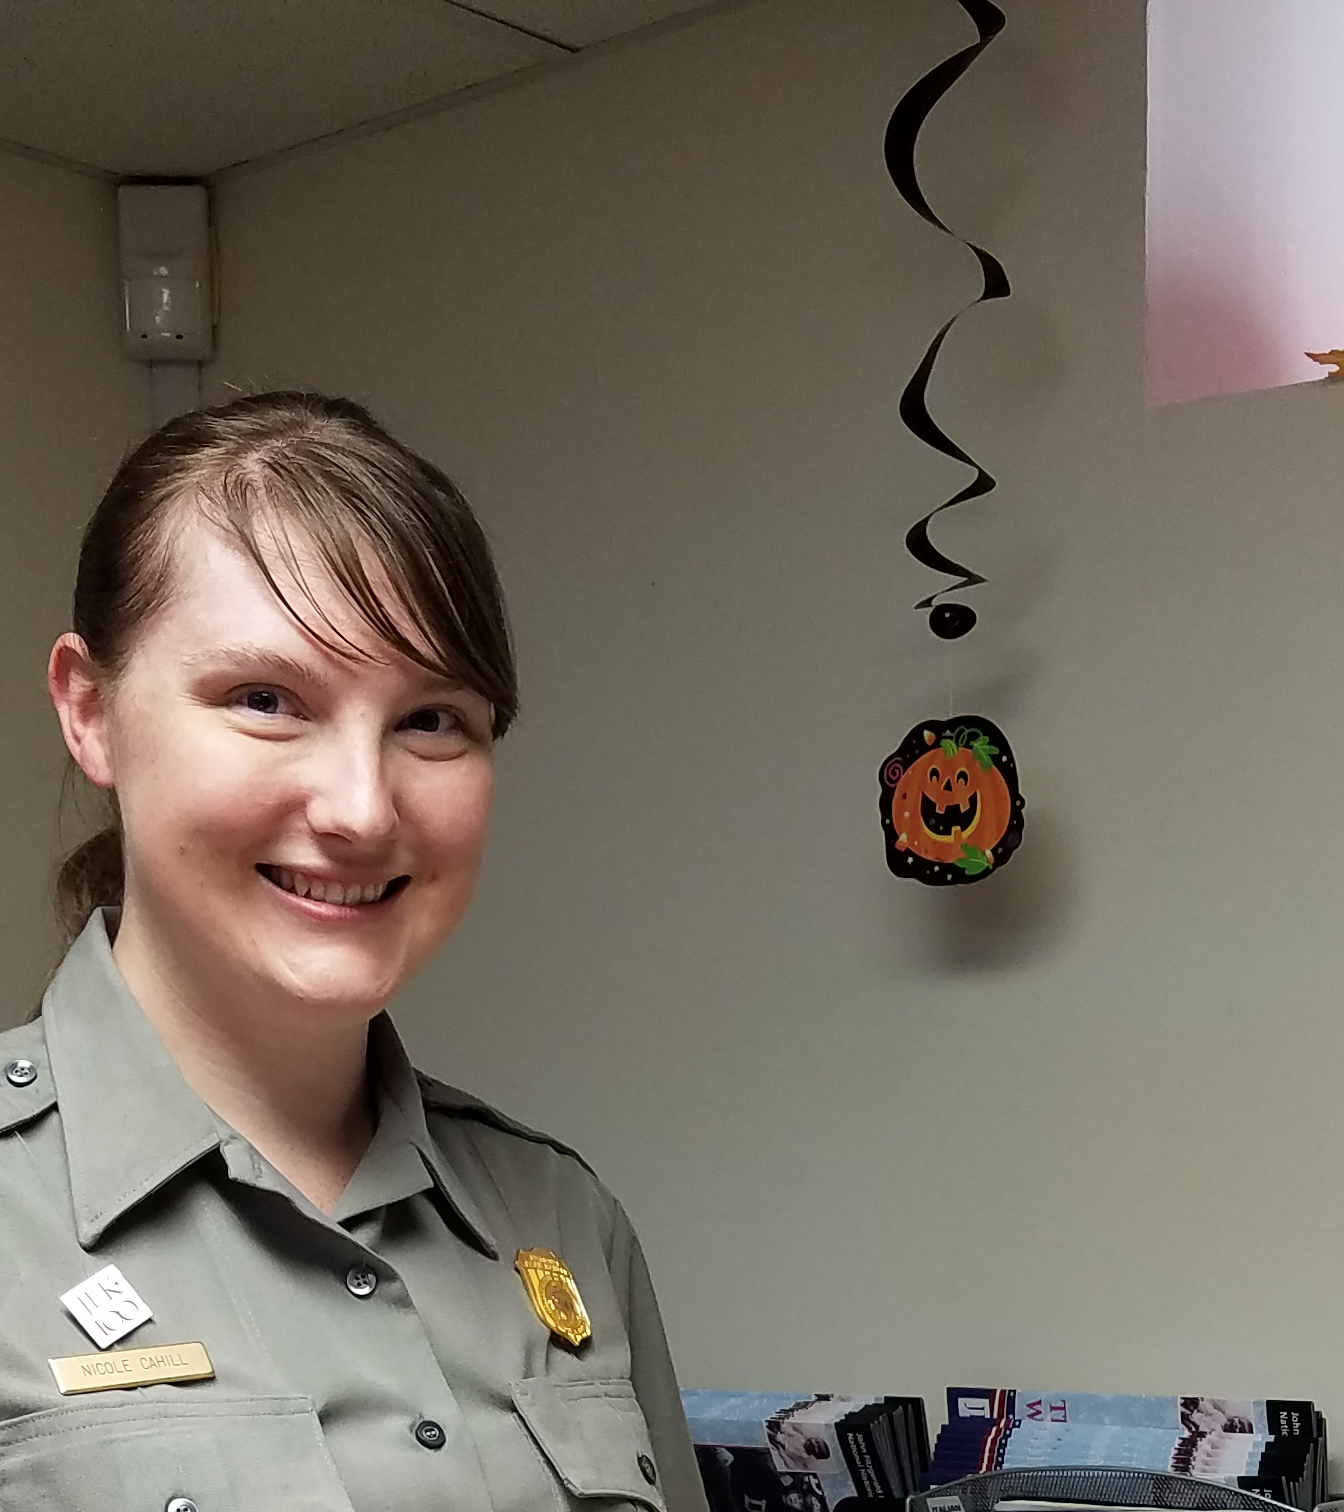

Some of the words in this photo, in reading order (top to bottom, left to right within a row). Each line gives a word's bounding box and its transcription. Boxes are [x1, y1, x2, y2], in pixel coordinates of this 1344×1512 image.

[80, 1358, 133, 1377] NICOLE
[139, 1353, 190, 1371] CAHILL
[1291, 1411, 1301, 1436] John
